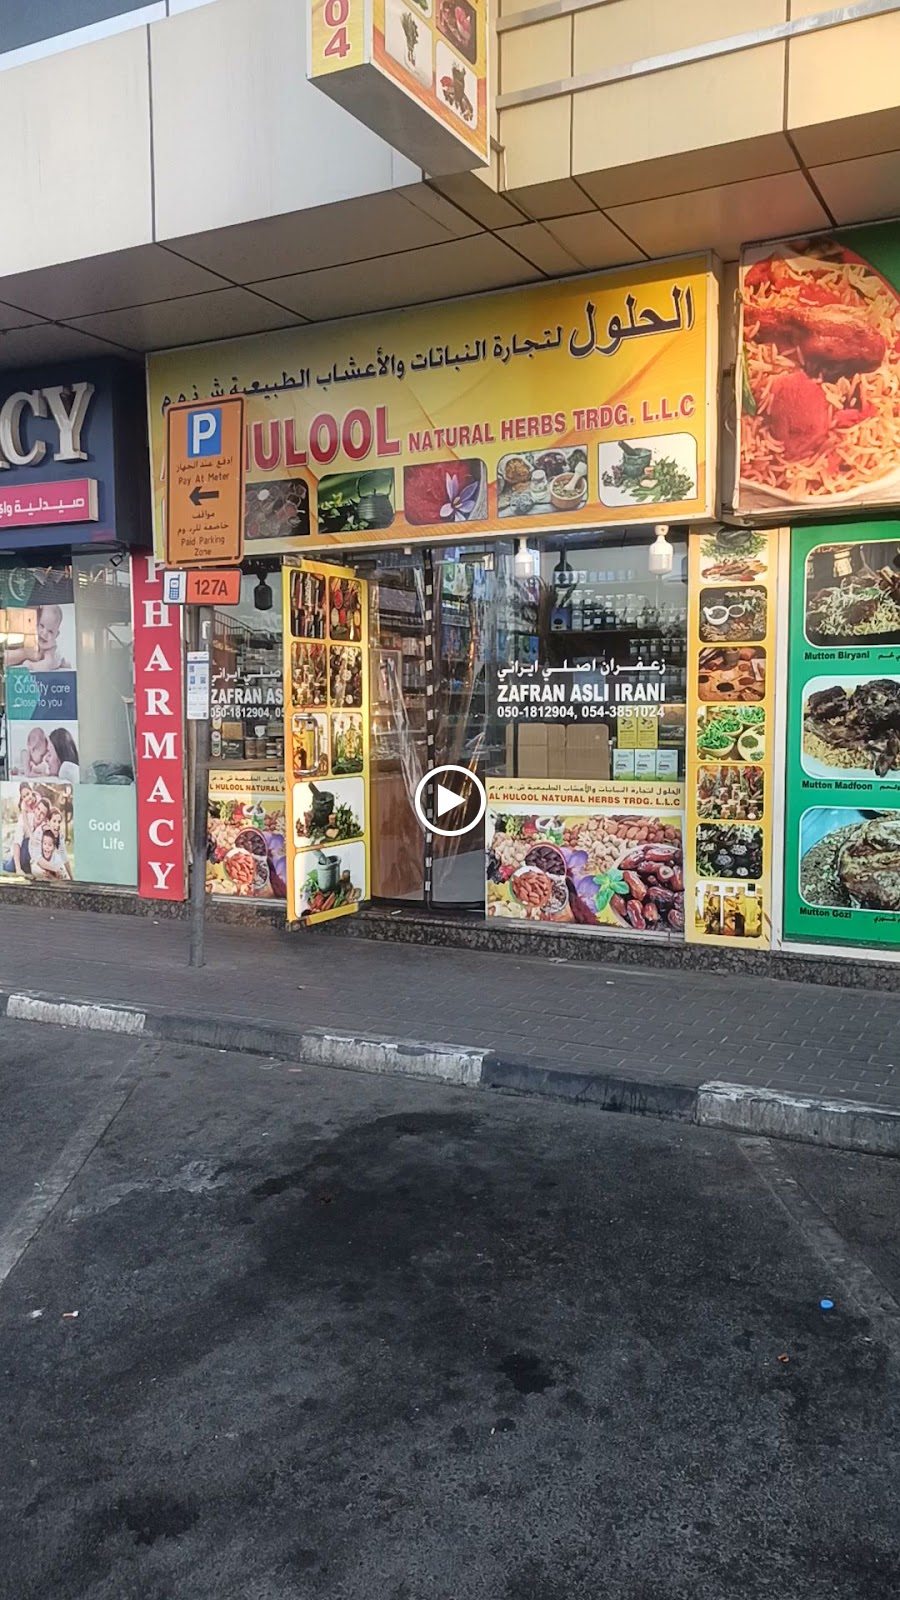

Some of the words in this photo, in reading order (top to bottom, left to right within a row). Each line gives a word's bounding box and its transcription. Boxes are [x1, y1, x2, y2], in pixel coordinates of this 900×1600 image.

[568, 284, 695, 358] الحلول
[493, 325, 563, 363] لتجارة
[410, 338, 487, 372] النباتات
[315, 346, 405, 391] والأعشاب
[0, 381, 96, 470] CY
[192, 412, 217, 455] P
[245, 404, 401, 473] ULOOL
[408, 423, 495, 454] NATURAL
[501, 412, 567, 442] HERBS
[572, 403, 636, 433] TRDG.
[642, 394, 695, 423] L.L.C
[178, 476, 191, 487] Pay
[195, 474, 205, 483] At
[207, 472, 230, 482] Meter
[14, 497, 85, 516] صيدلية
[180, 537, 196, 547] Paid
[199, 535, 226, 545] Parking
[194, 548, 212, 557] Zone
[194, 579, 229, 597] 127A
[804, 651, 836, 660] Mutton
[837, 650, 870, 661] Biryani
[600, 656, 666, 676] زعفران
[243, 666, 282, 685] صلي
[14, 681, 49, 696] Quality
[51, 684, 71, 694] care
[210, 688, 262, 704] ZAFRAN
[266, 688, 283, 704] AS
[497, 684, 566, 702] ZAFRAN
[570, 683, 609, 702] ASLI
[615, 683, 666, 702] IRANI
[48, 699, 63, 709] you
[497, 705, 578, 719] 050-1812904,
[581, 704, 665, 718] 054-3851024
[210, 706, 273, 719] 050-1812904,
[802, 780, 833, 790] Mutton
[834, 781, 873, 791] Madfoon
[489, 792, 501, 800] AL
[502, 793, 540, 802] HULOOL
[541, 794, 586, 803] NATURAL
[588, 795, 621, 804] HERBS
[623, 796, 653, 805] TRDG.
[655, 797, 681, 806] L.L.C
[88, 818, 121, 832] Good
[102, 837, 125, 850] Life
[799, 907, 830, 917] Mutton
[832, 909, 852, 919] Gozi
